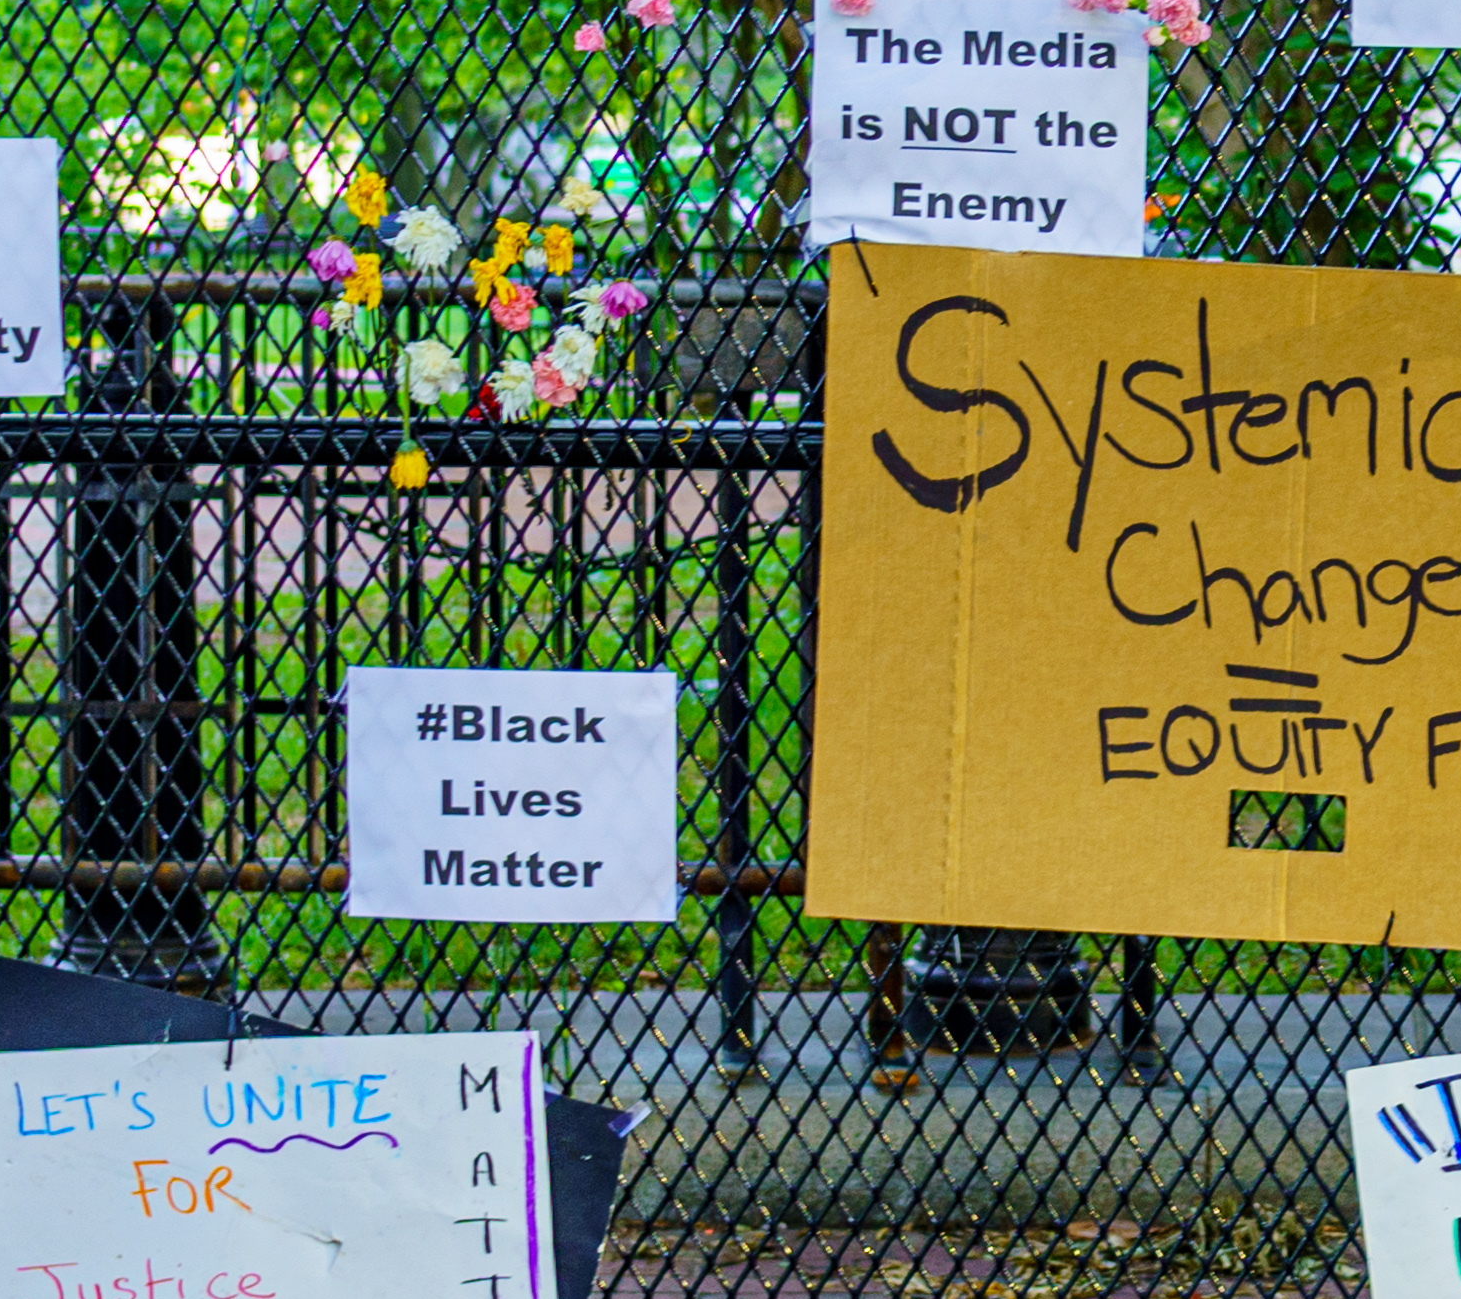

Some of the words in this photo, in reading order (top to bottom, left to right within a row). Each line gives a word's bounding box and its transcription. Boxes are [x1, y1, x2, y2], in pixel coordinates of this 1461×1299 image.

[846, 29, 945, 65] The
[962, 30, 1117, 70] Media
[840, 106, 883, 141] is
[903, 108, 1015, 144] NOT
[1035, 111, 1118, 147] the
[891, 182, 1067, 231] Enemy
[416, 704, 606, 744] #Black
[1098, 704, 1393, 785] EQUITY
[440, 780, 583, 817] Lives
[423, 850, 604, 888] Matter
